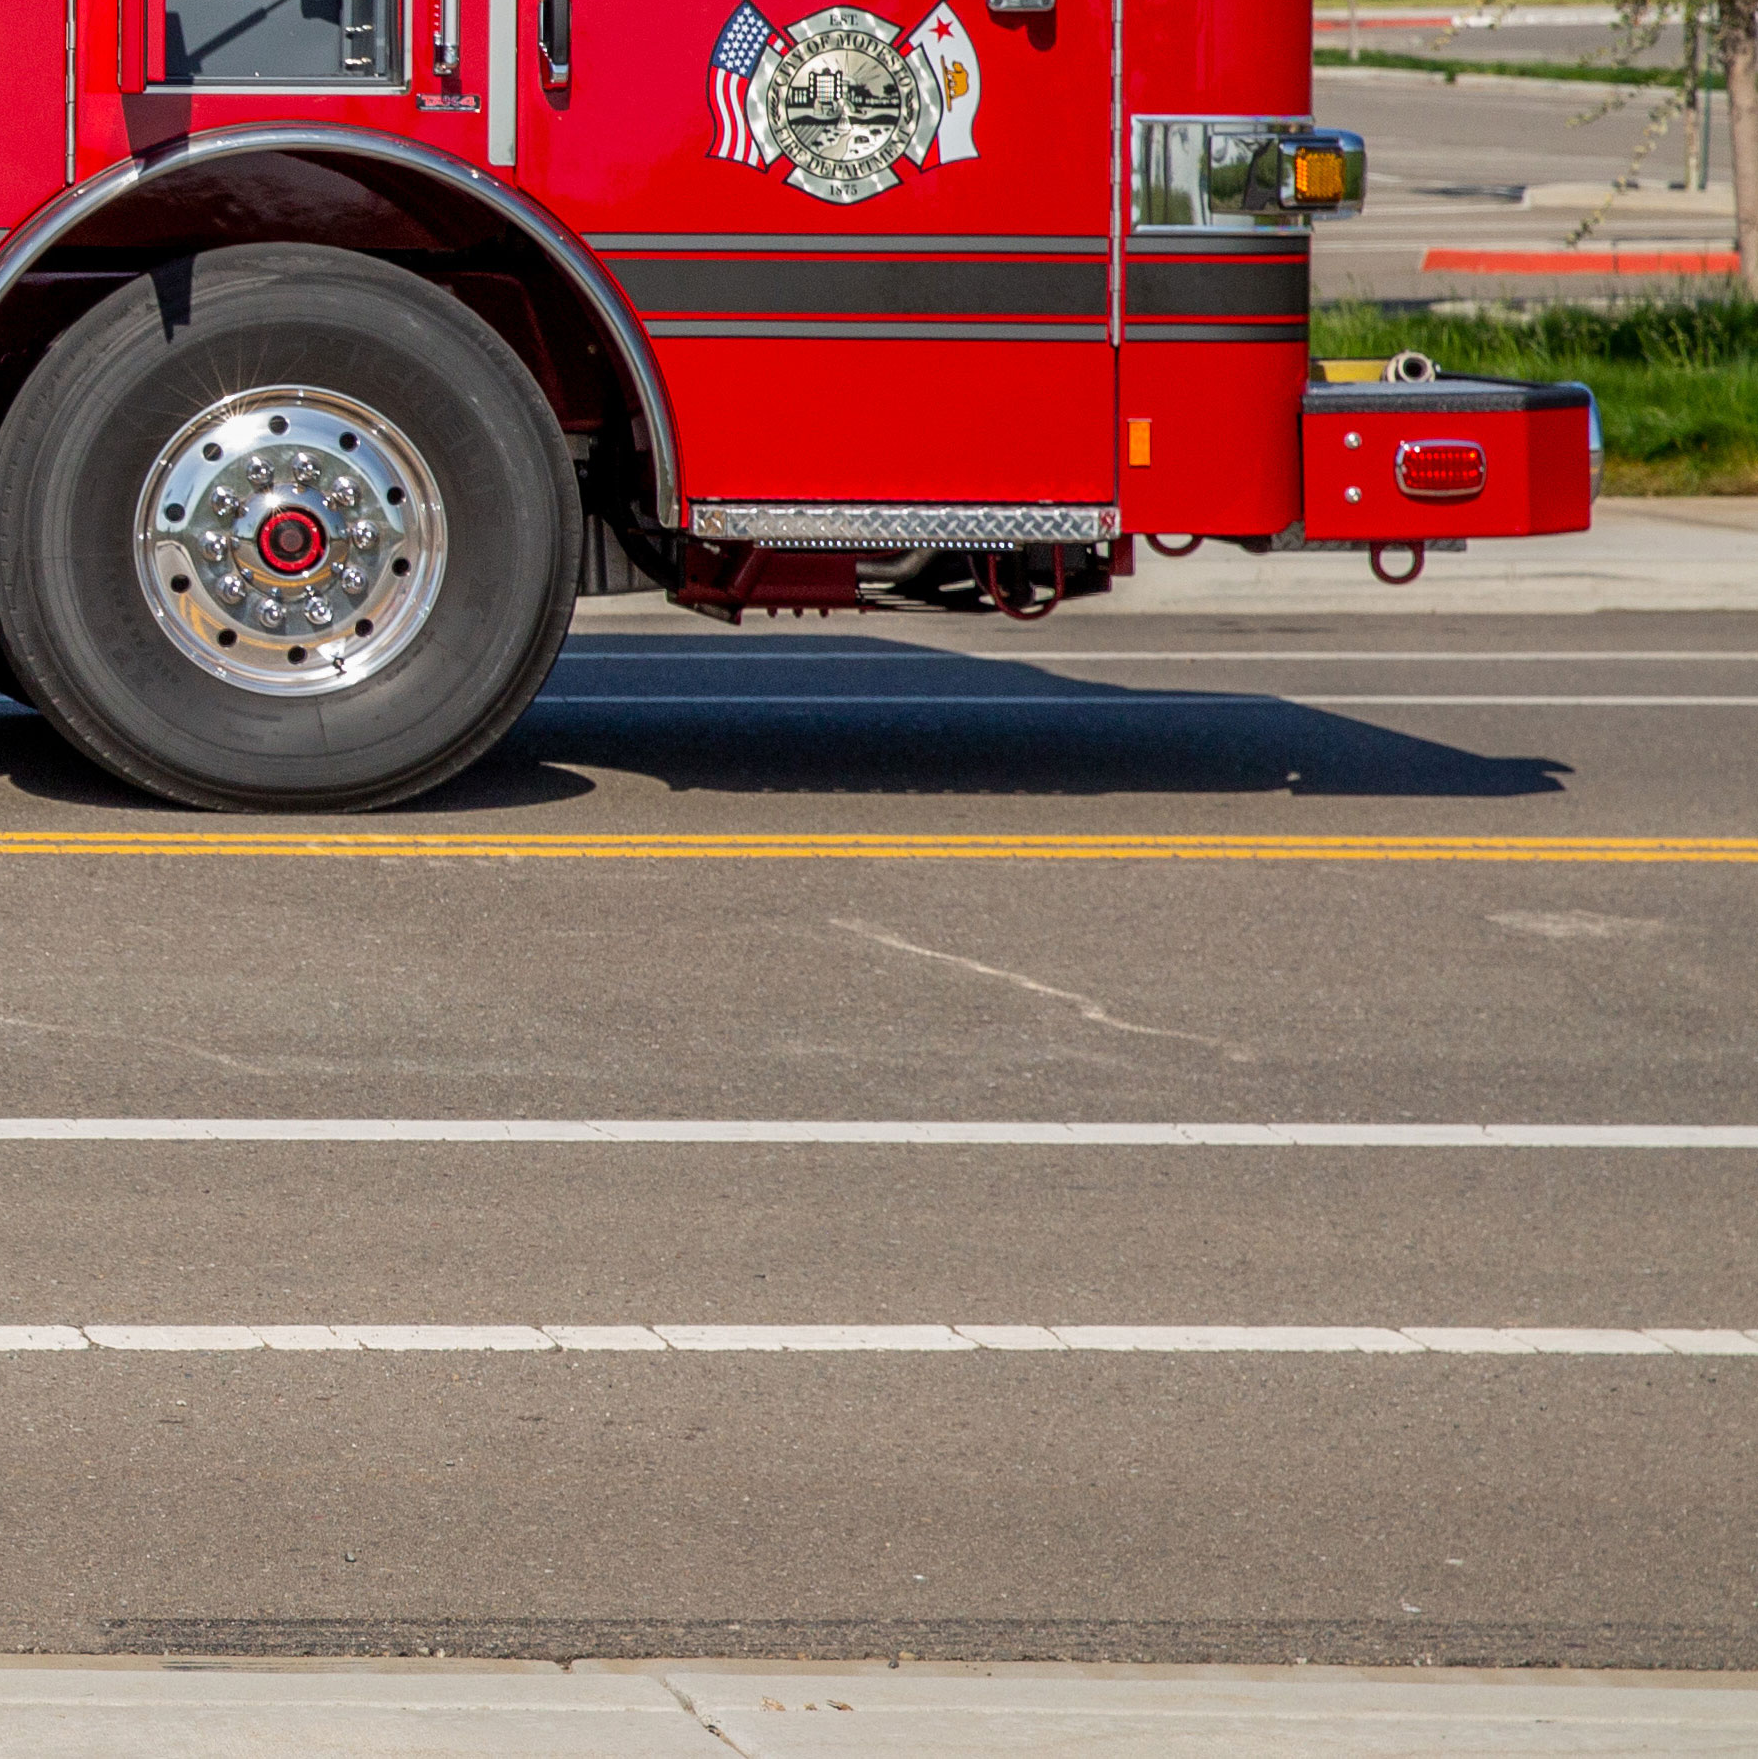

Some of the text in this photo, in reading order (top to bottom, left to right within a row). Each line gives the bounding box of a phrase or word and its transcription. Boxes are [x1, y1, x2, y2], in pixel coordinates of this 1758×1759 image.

[829, 14, 858, 26] EST.
[774, 34, 914, 87] CITY OF MODESTO
[774, 126, 911, 177] FIRE DEPARTMENT
[829, 184, 858, 196] 1875
